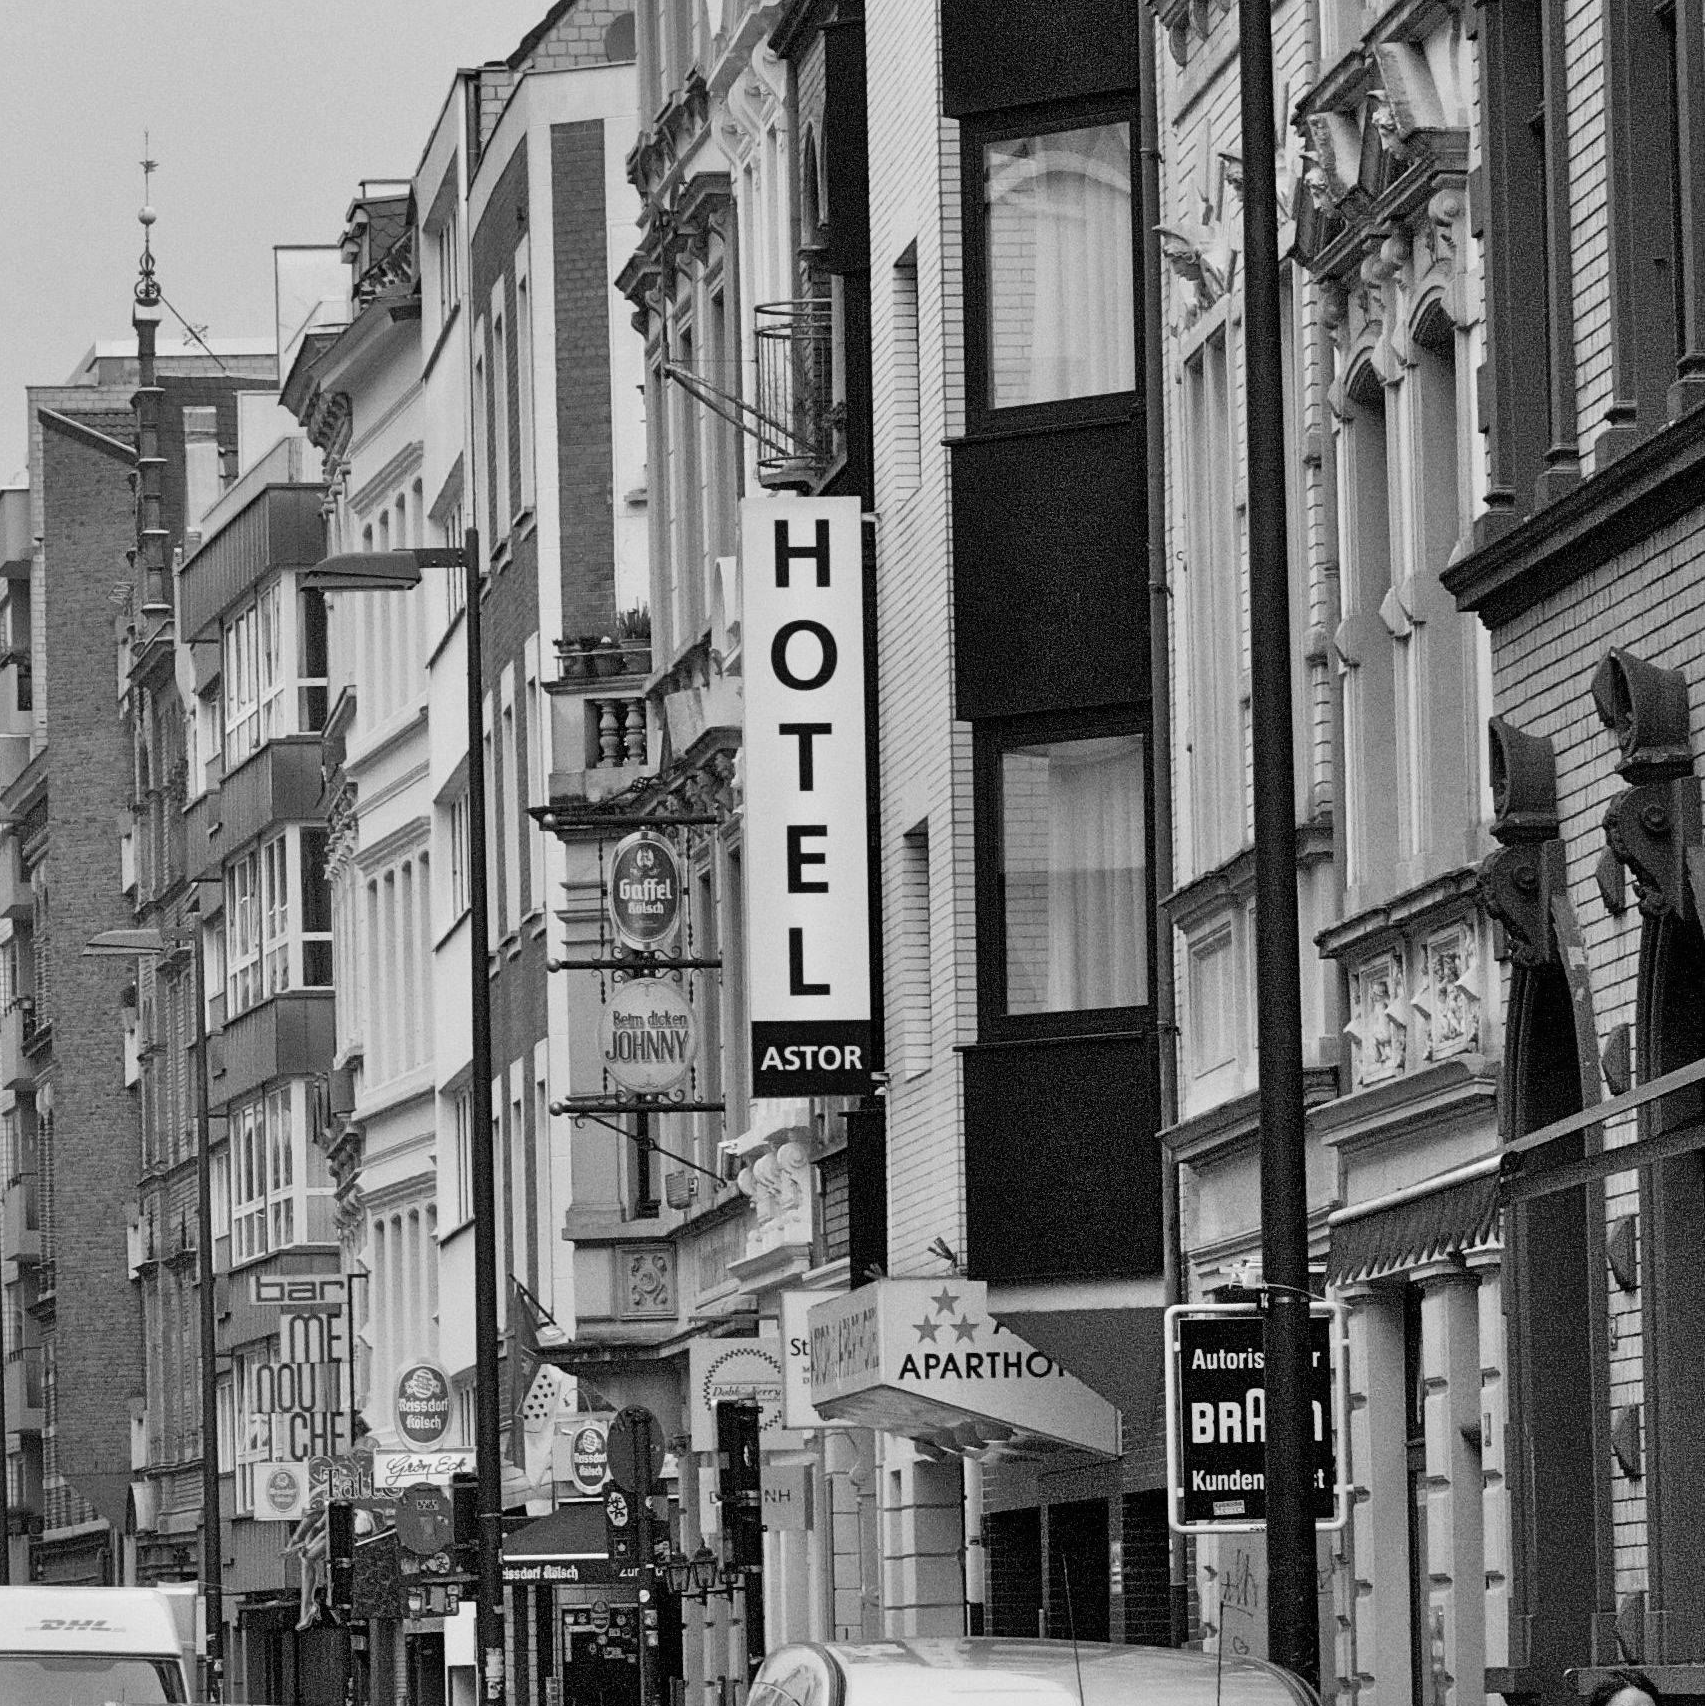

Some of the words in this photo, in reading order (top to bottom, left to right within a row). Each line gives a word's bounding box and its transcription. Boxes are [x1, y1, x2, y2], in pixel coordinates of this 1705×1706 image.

[771, 518, 837, 996] HOTEL
[619, 878, 672, 902] Gaffel
[605, 1030, 690, 1061] JOHNNY
[760, 1045, 863, 1071] ASTOR
[256, 1276, 345, 1303] bar
[1192, 1348, 1321, 1370] Autorisr
[398, 1397, 449, 1413] Reissdorf
[1192, 1468, 1325, 1492] Kundent
[39, 1619, 114, 1632] DHL
